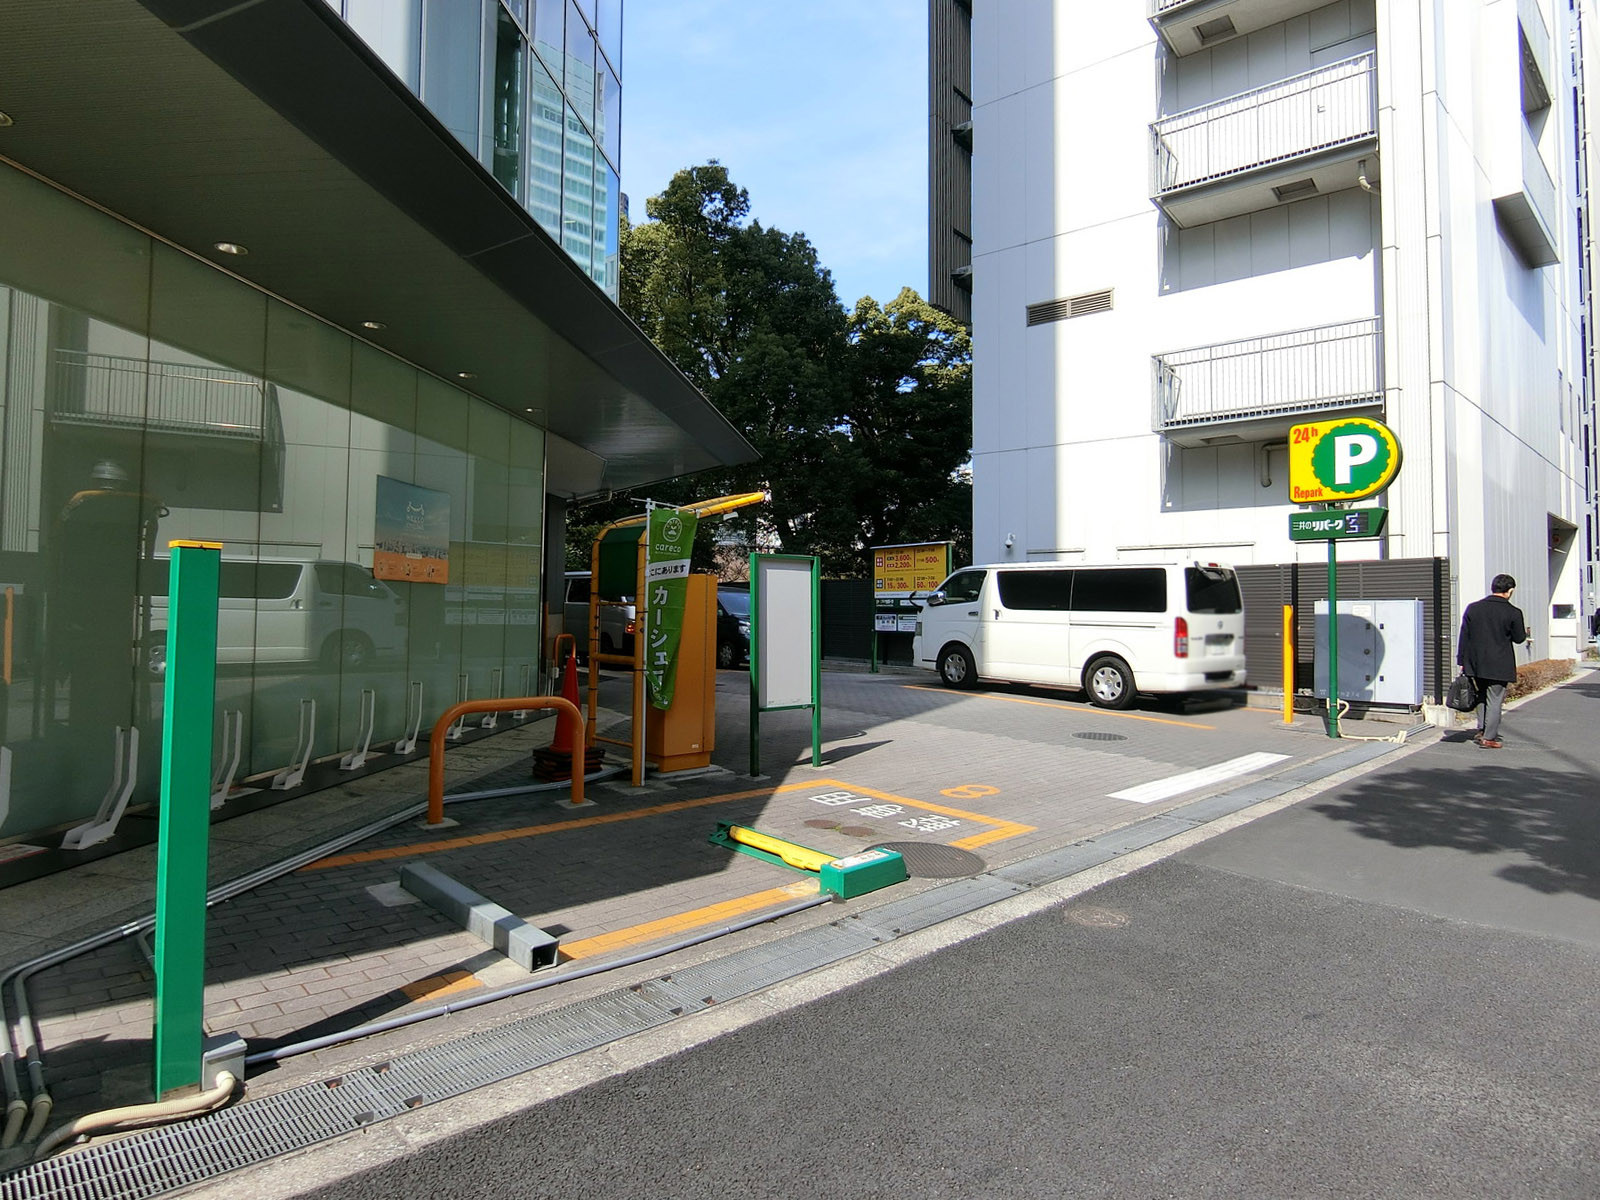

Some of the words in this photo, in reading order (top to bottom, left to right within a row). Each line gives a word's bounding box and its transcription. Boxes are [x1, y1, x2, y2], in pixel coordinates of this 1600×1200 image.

[1293, 427, 1318, 444] 24h
[1335, 434, 1378, 485] P
[1294, 486, 1323, 499] Repark
[1292, 519, 1344, 531] 三井のリパーク
[655, 543, 681, 553] careco
[940, 784, 1001, 799] 8
[808, 791, 961, 833] 軽専用
